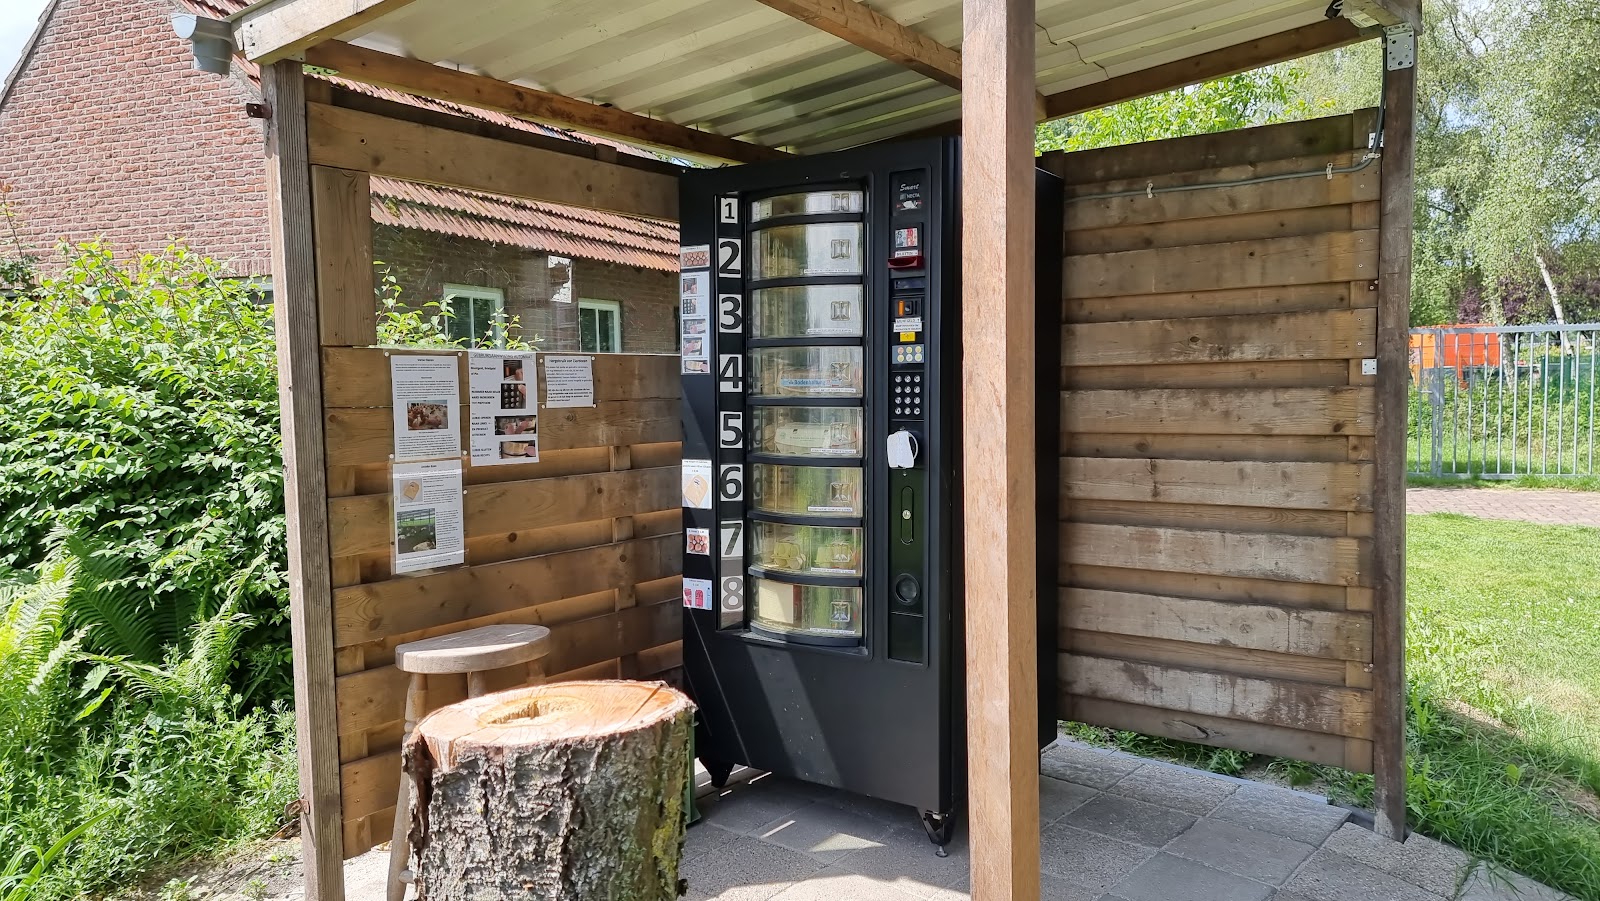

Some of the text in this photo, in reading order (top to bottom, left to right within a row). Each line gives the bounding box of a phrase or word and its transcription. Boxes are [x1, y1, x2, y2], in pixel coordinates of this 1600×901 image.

[899, 183, 920, 191] Smart
[724, 202, 735, 220] 1
[719, 240, 741, 275] 2
[720, 296, 742, 330] 3
[720, 356, 742, 389] 4
[721, 413, 743, 446] 5
[720, 466, 742, 499] 6
[721, 522, 743, 556] 7
[722, 576, 744, 611] 8
